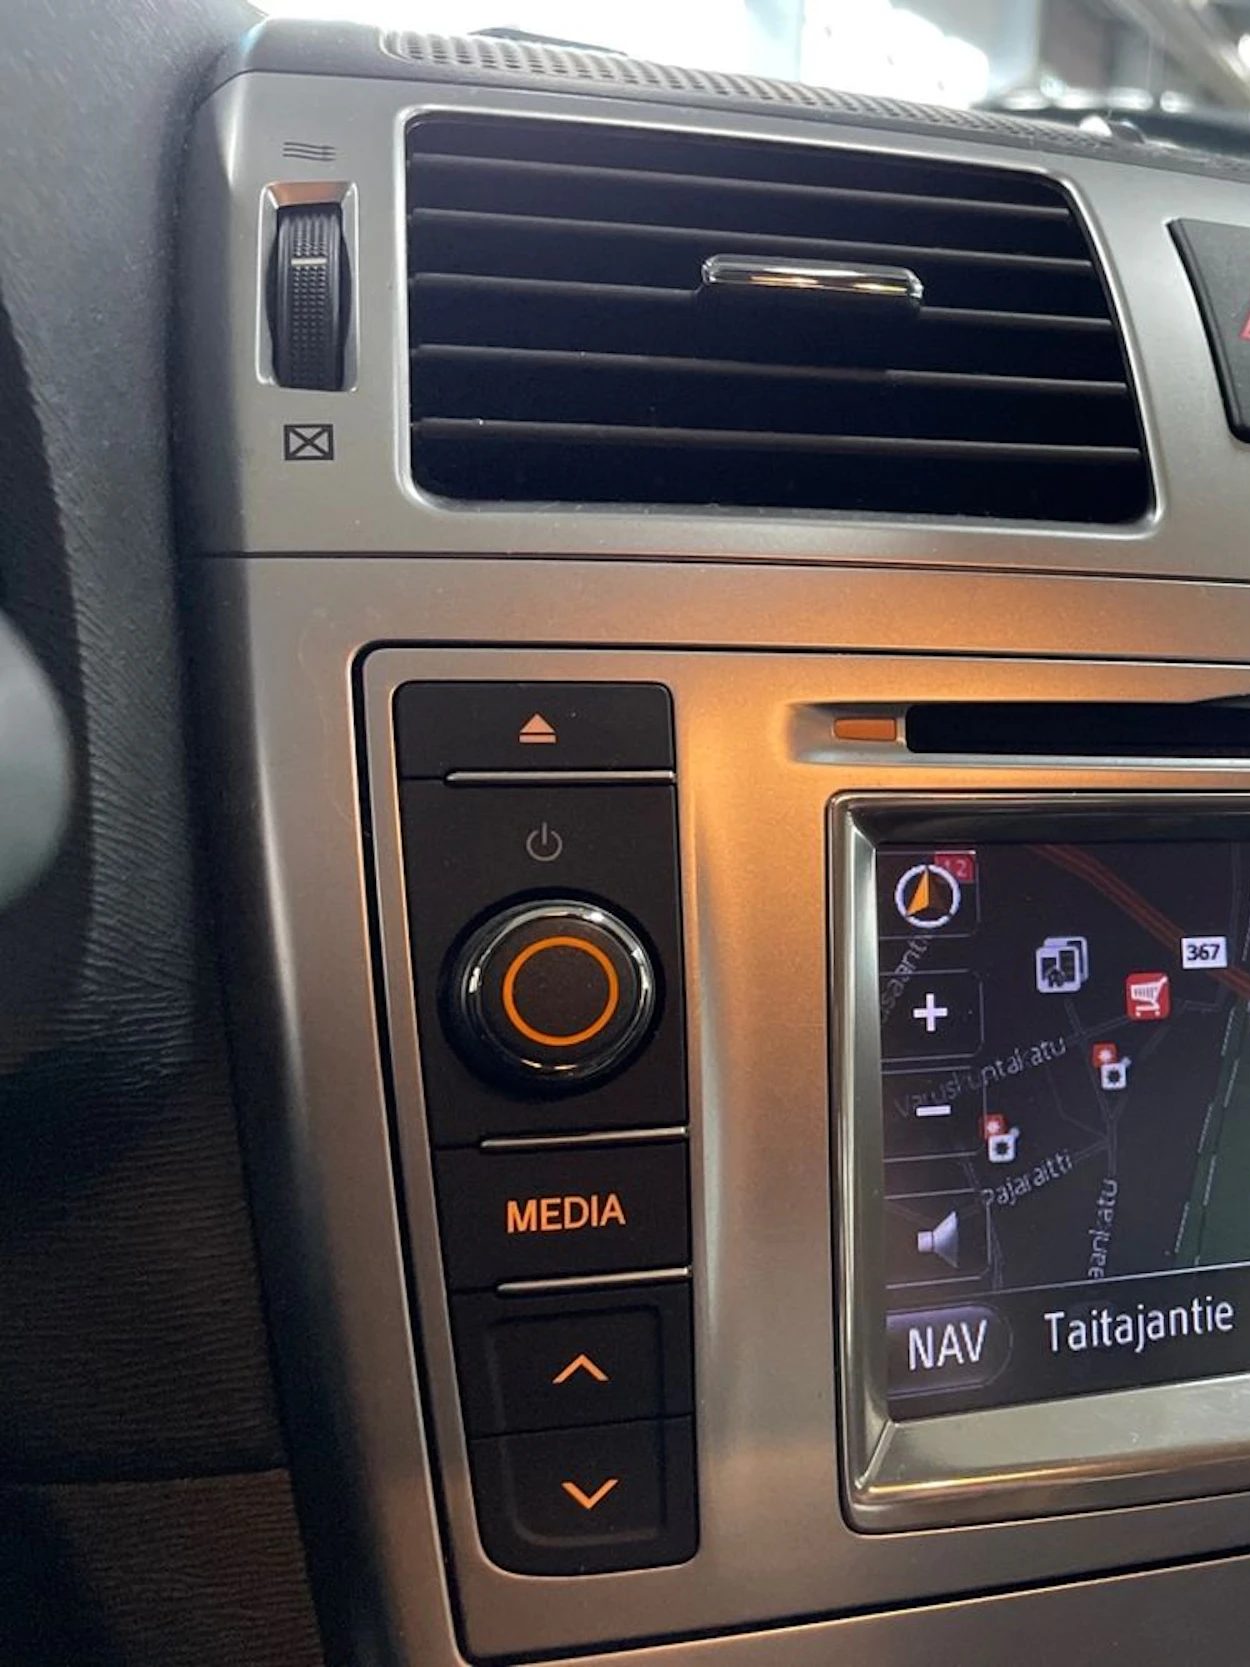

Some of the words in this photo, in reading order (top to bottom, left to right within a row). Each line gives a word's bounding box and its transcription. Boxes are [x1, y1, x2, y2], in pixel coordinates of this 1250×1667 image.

[1186, 943, 1221, 962] 367
[505, 1192, 627, 1235] MEDIA
[907, 1318, 988, 1372] NAV
[1043, 1294, 1235, 1354] Taitajantie
